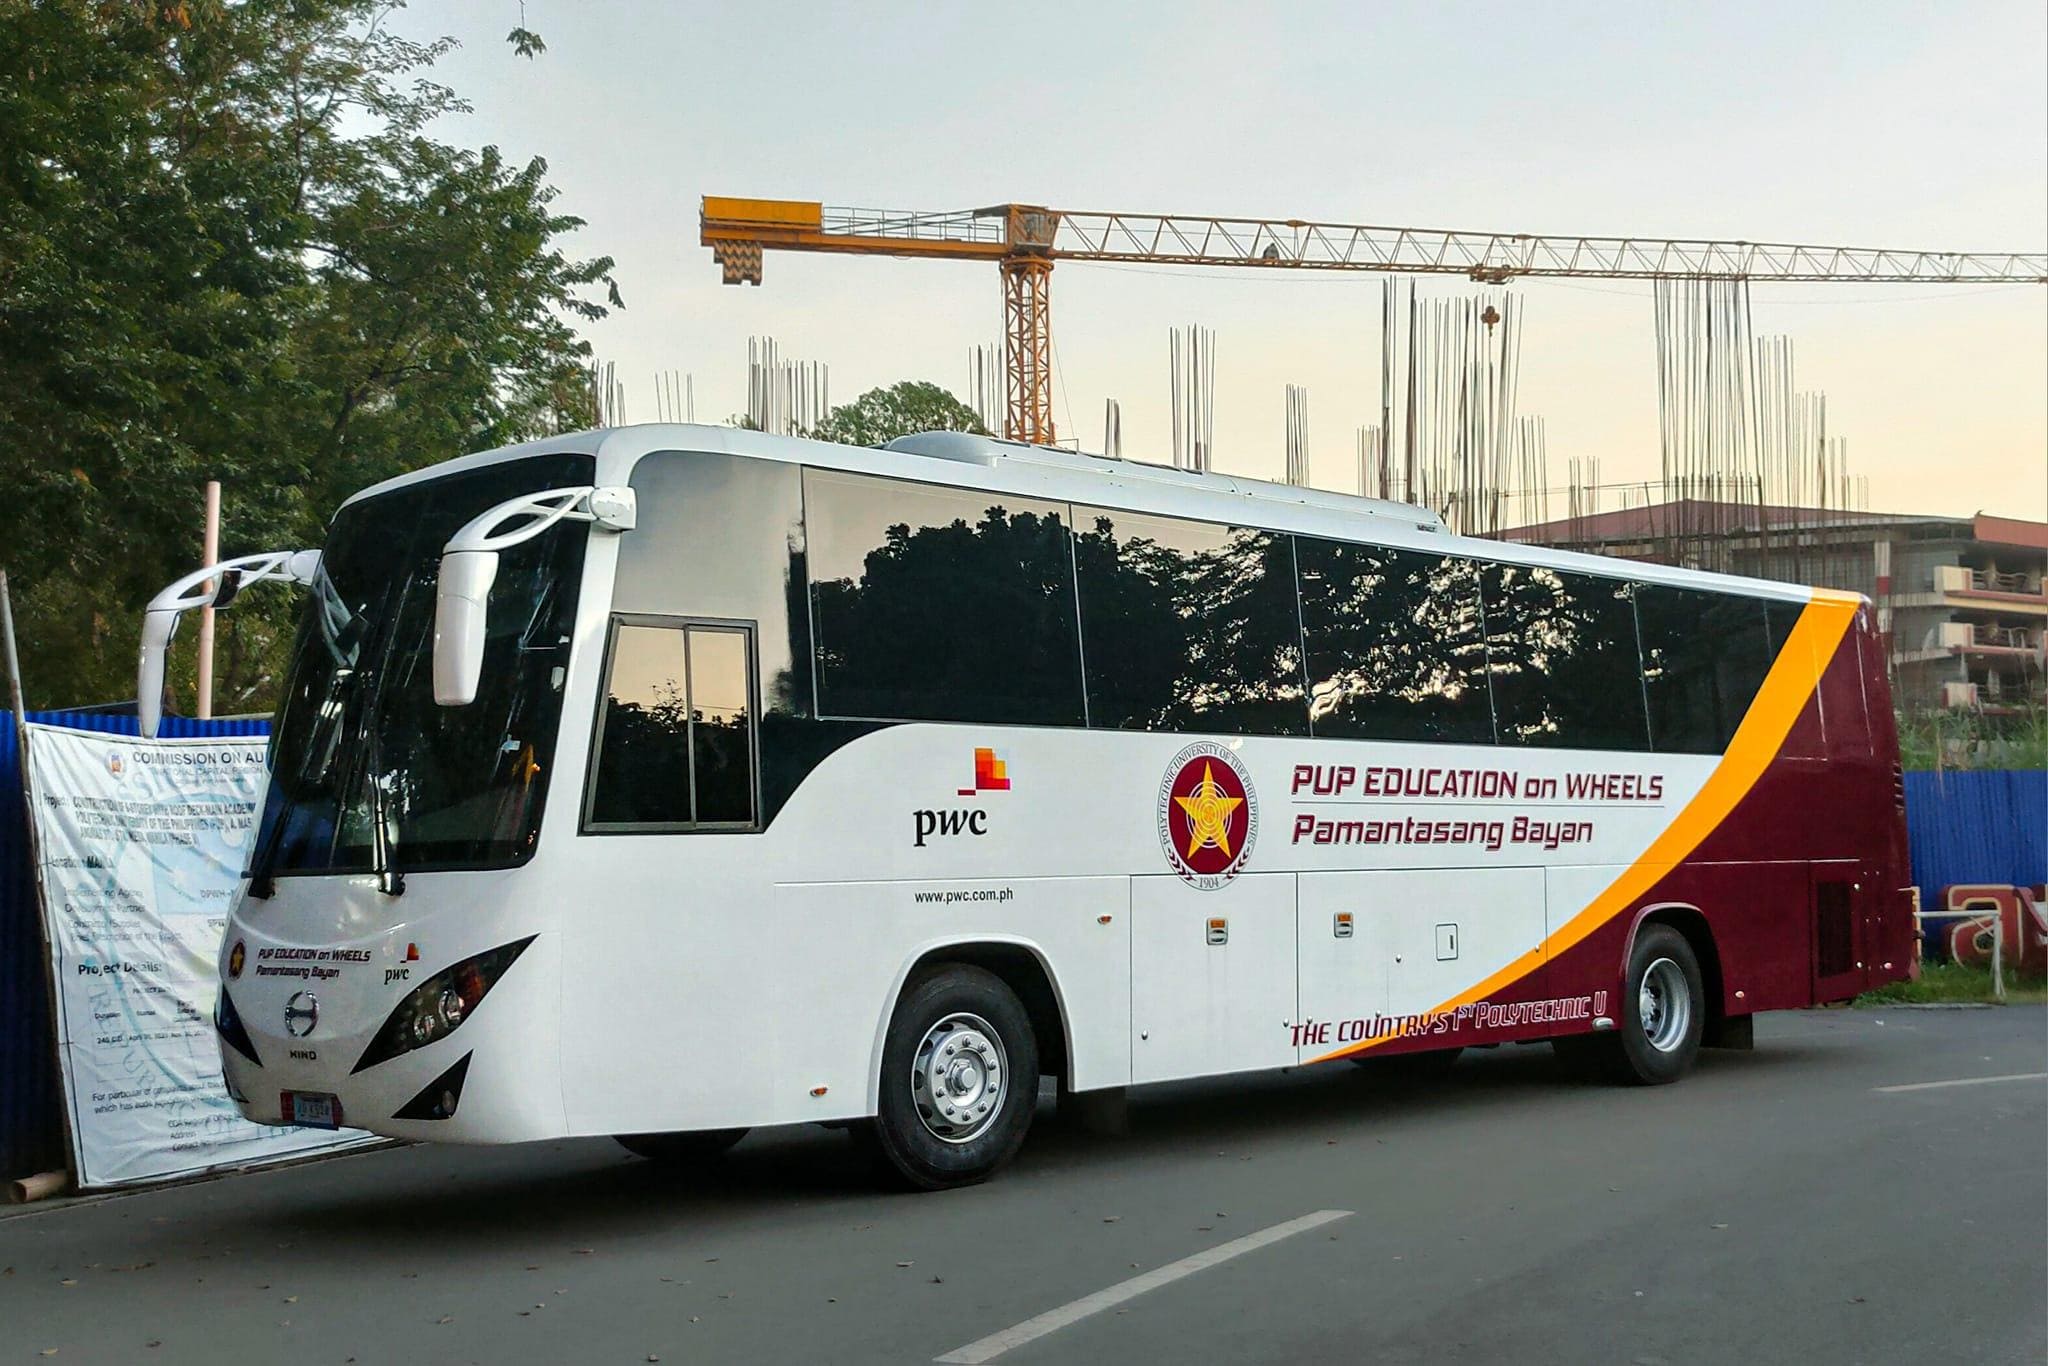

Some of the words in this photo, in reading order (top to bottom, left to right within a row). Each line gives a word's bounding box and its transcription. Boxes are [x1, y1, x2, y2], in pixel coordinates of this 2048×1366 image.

[133, 752, 216, 764] COMMISSION
[221, 752, 240, 764] ON
[1291, 764, 1356, 796] PUP
[1363, 767, 1519, 799] EDUCATION
[1524, 777, 1557, 800] on
[1566, 772, 1664, 801] WHEELS
[1159, 768, 1178, 846] POLYTECHNIC
[1174, 744, 1220, 769] UNIVERSITY
[1219, 749, 1231, 761] OF
[1230, 757, 1246, 774] THE
[913, 808, 987, 847] pwc
[1292, 814, 1504, 851] Pamantasang
[1510, 816, 1593, 850] Bayan
[1200, 877, 1219, 889] 1904
[915, 887, 1013, 904] www.pwc.com.ph
[257, 948, 273, 960] PUP
[274, 948, 317, 961] EDUCATION
[318, 951, 330, 961] on
[332, 950, 371, 962] WHEELS
[311, 966, 340, 980] Bayan
[384, 968, 410, 985] pwc
[1290, 1022, 1331, 1047] THE
[1338, 1012, 1449, 1042] COUNTRY'S
[1475, 996, 1592, 1028] POLYTECHNIC
[1593, 990, 1608, 1014] U
[290, 1050, 317, 1060] HINO
